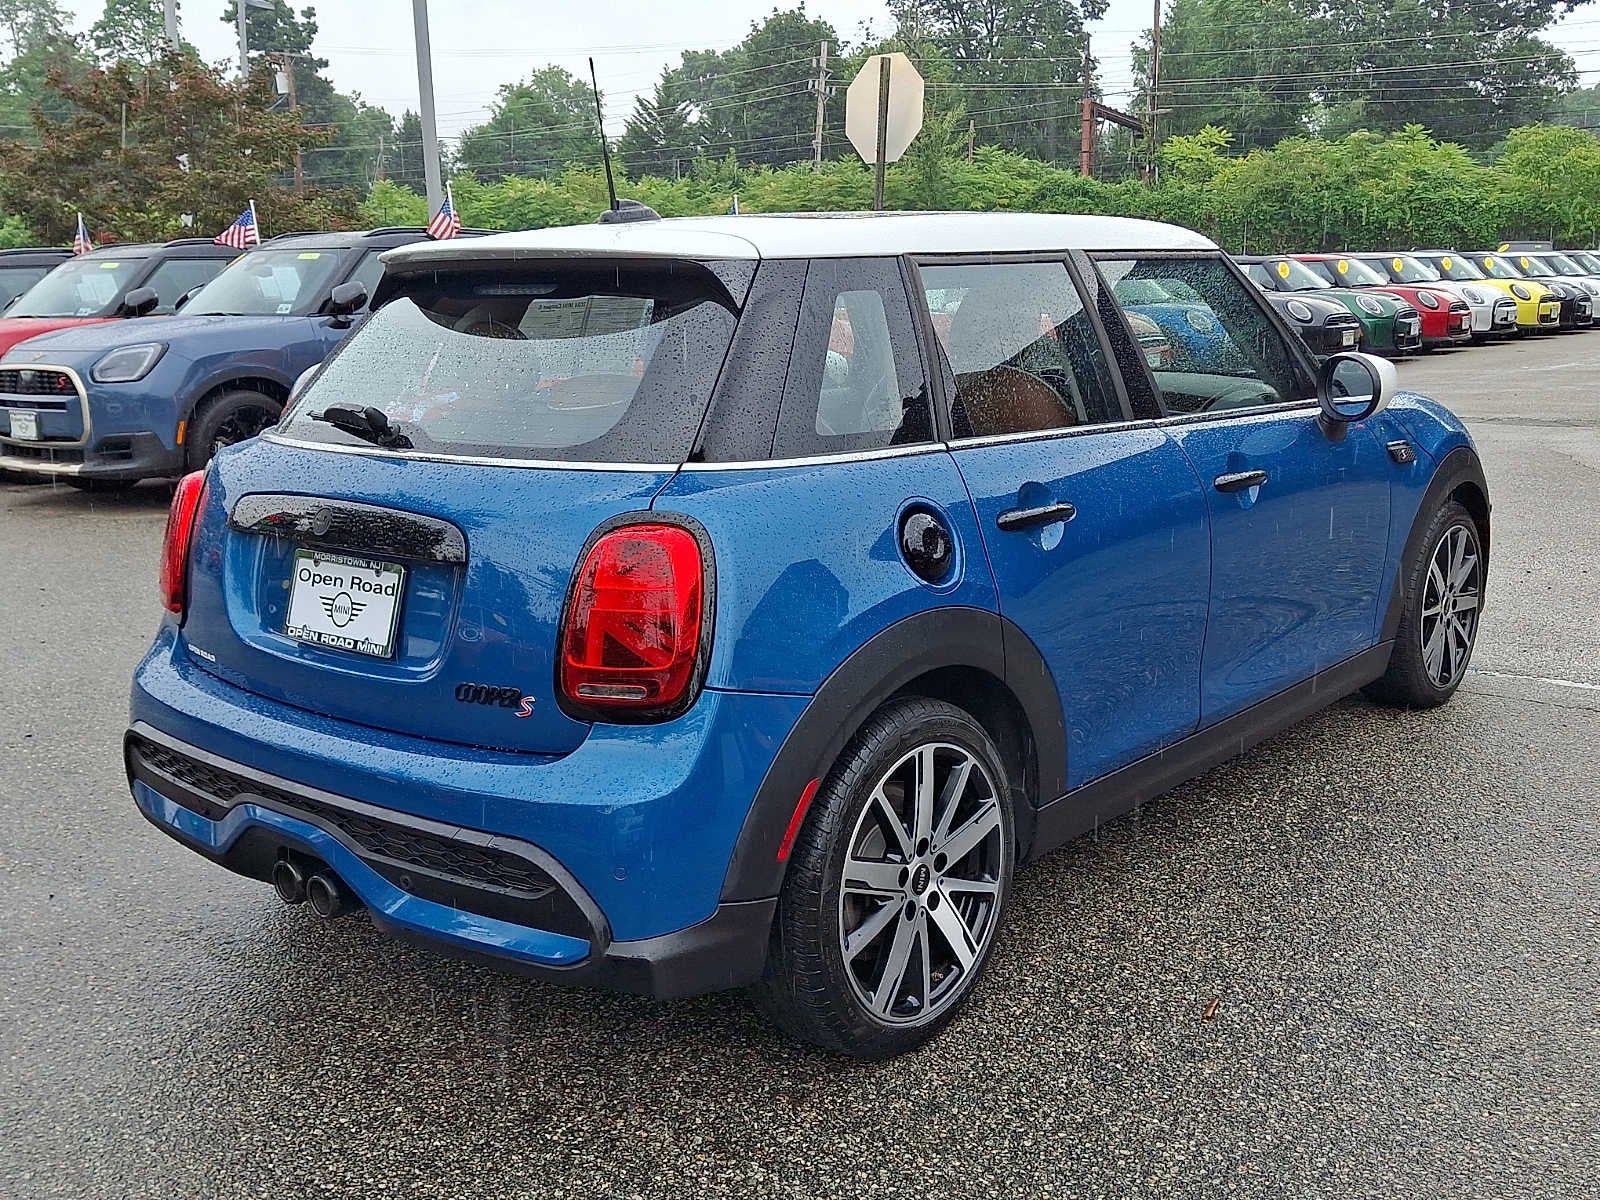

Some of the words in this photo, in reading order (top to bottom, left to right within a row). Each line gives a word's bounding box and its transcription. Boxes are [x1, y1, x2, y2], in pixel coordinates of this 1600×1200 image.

[57, 376, 68, 389] S
[370, 562, 381, 570] NJ
[299, 568, 344, 588] Open
[350, 576, 396, 597] Road
[333, 604, 351, 616] MINI
[287, 627, 318, 641] OPEN
[320, 634, 354, 649] ROAD
[356, 641, 384, 655] MINI
[455, 681, 521, 709] COOPER
[514, 696, 536, 717] S
[916, 867, 927, 892] MINI
